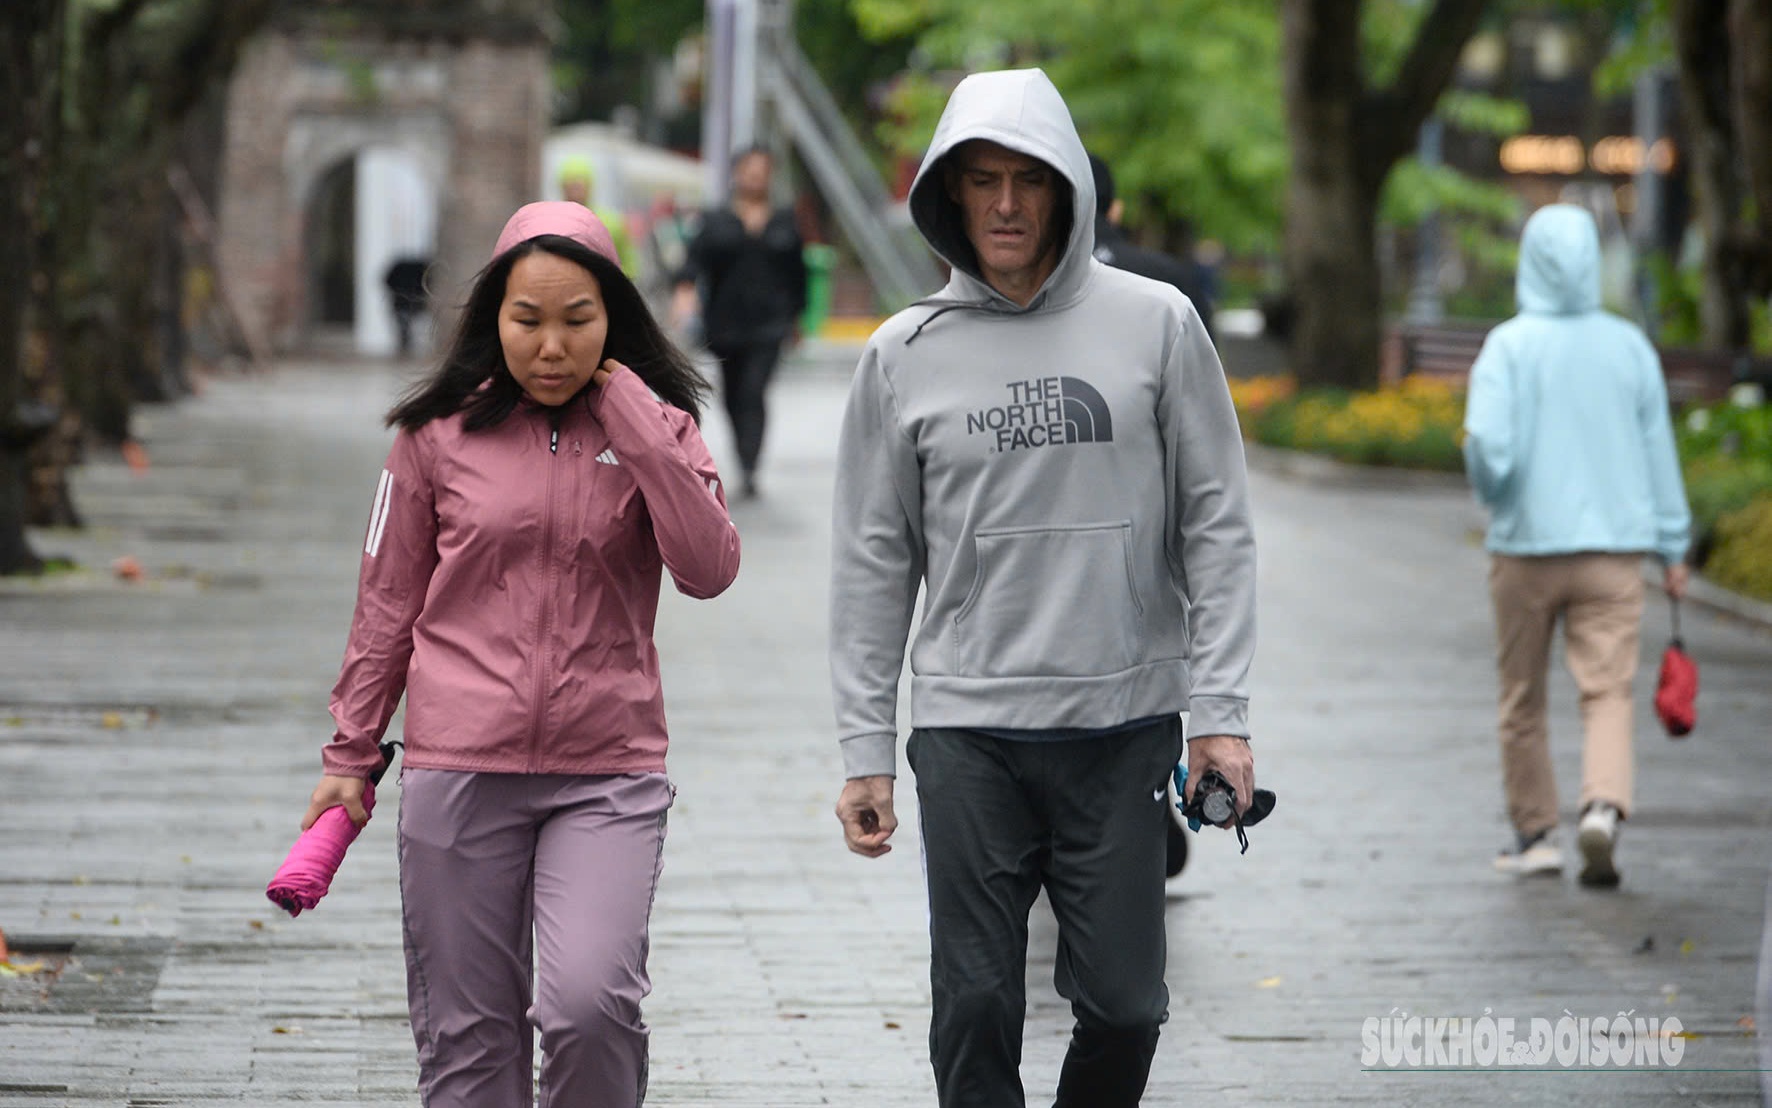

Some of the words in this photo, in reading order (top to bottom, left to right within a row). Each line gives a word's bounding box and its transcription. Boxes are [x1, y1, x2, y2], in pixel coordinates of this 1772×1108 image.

[1006, 376, 1060, 404] THE
[966, 400, 1062, 435] NORTH
[996, 423, 1065, 453] FACE
